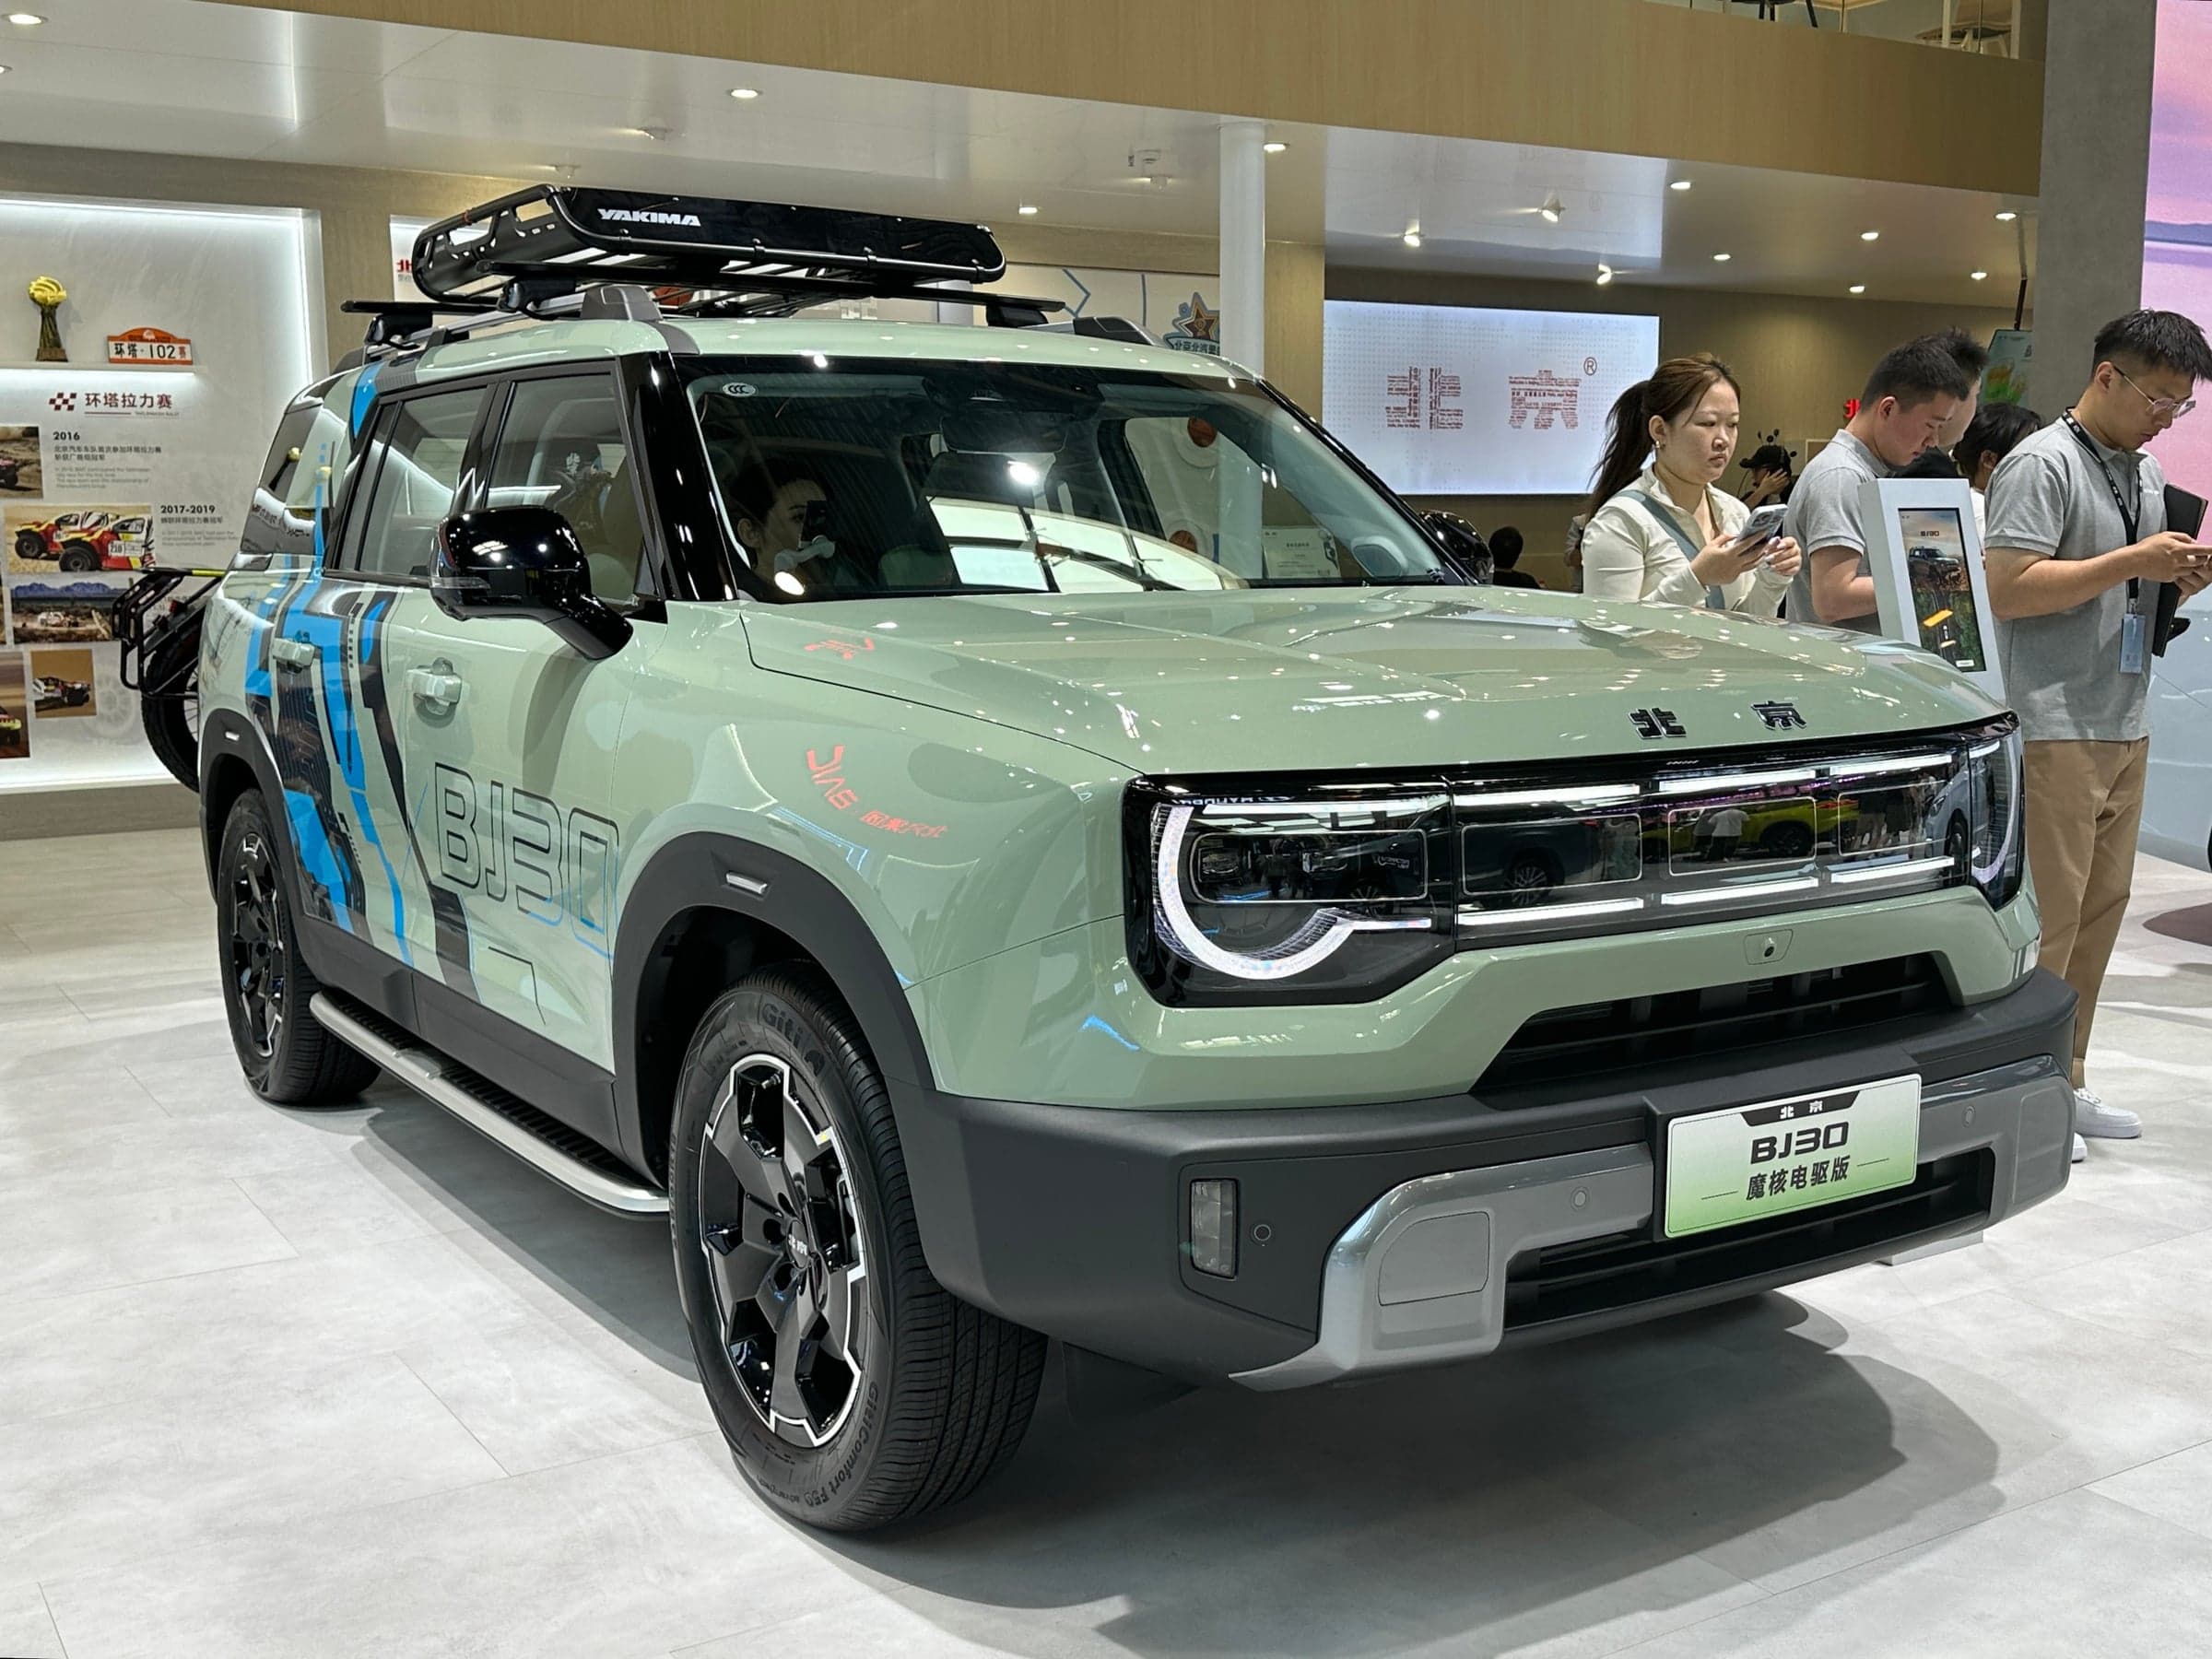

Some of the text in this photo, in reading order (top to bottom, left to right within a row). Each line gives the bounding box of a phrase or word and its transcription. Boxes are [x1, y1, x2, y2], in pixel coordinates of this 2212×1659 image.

[597, 208, 701, 227] YAKIMA
[85, 393, 172, 409] 环塔拉力赛
[53, 431, 80, 441] 2016
[160, 505, 216, 514] 2017-2019
[1628, 700, 1807, 738] 北京
[1780, 1100, 1824, 1119] 北京
[1750, 1122, 1849, 1164] BJ30
[1746, 1155, 1851, 1200] 魔核电驱版
